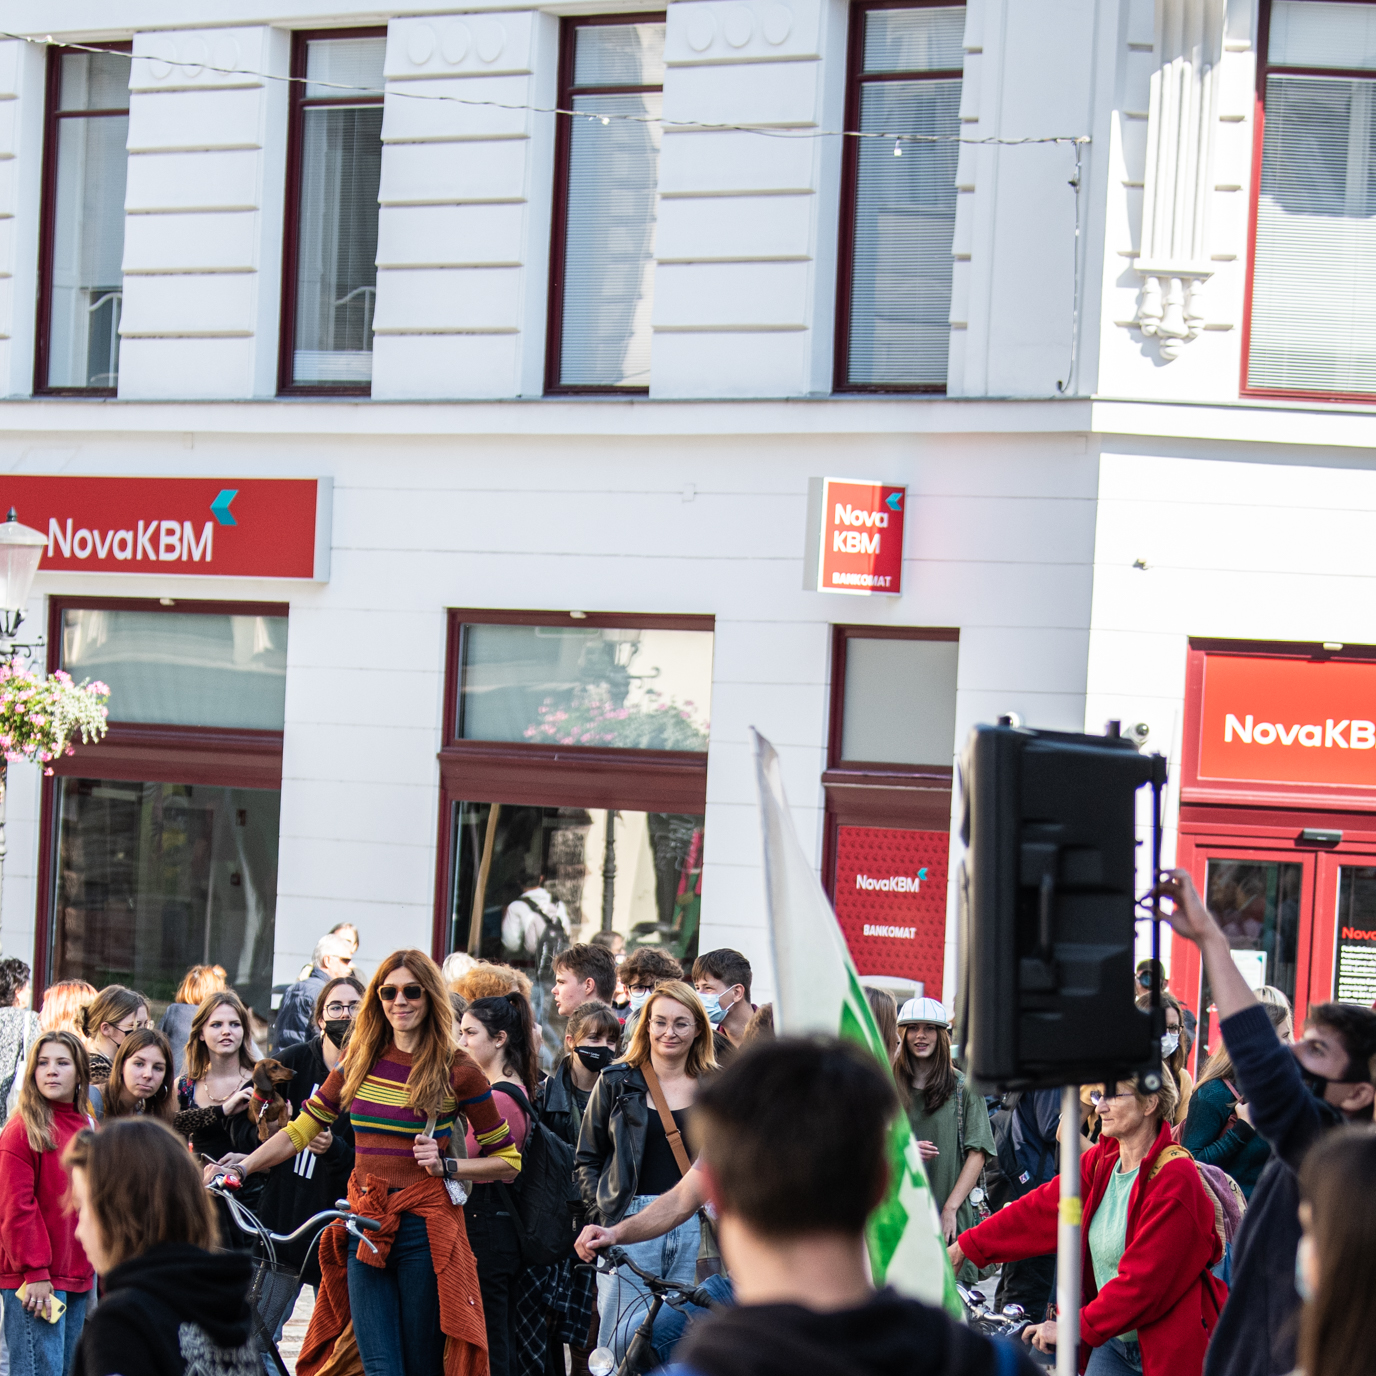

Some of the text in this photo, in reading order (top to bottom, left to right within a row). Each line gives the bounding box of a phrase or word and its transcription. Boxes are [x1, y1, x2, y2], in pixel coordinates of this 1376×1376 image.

[834, 503, 889, 528] Nova
[48, 518, 213, 562] NovaKBM
[833, 530, 881, 554] KBM
[832, 572, 892, 587] BANKOMAT
[856, 874, 920, 893] NovaKBM
[863, 924, 917, 939] BANKOMAT
